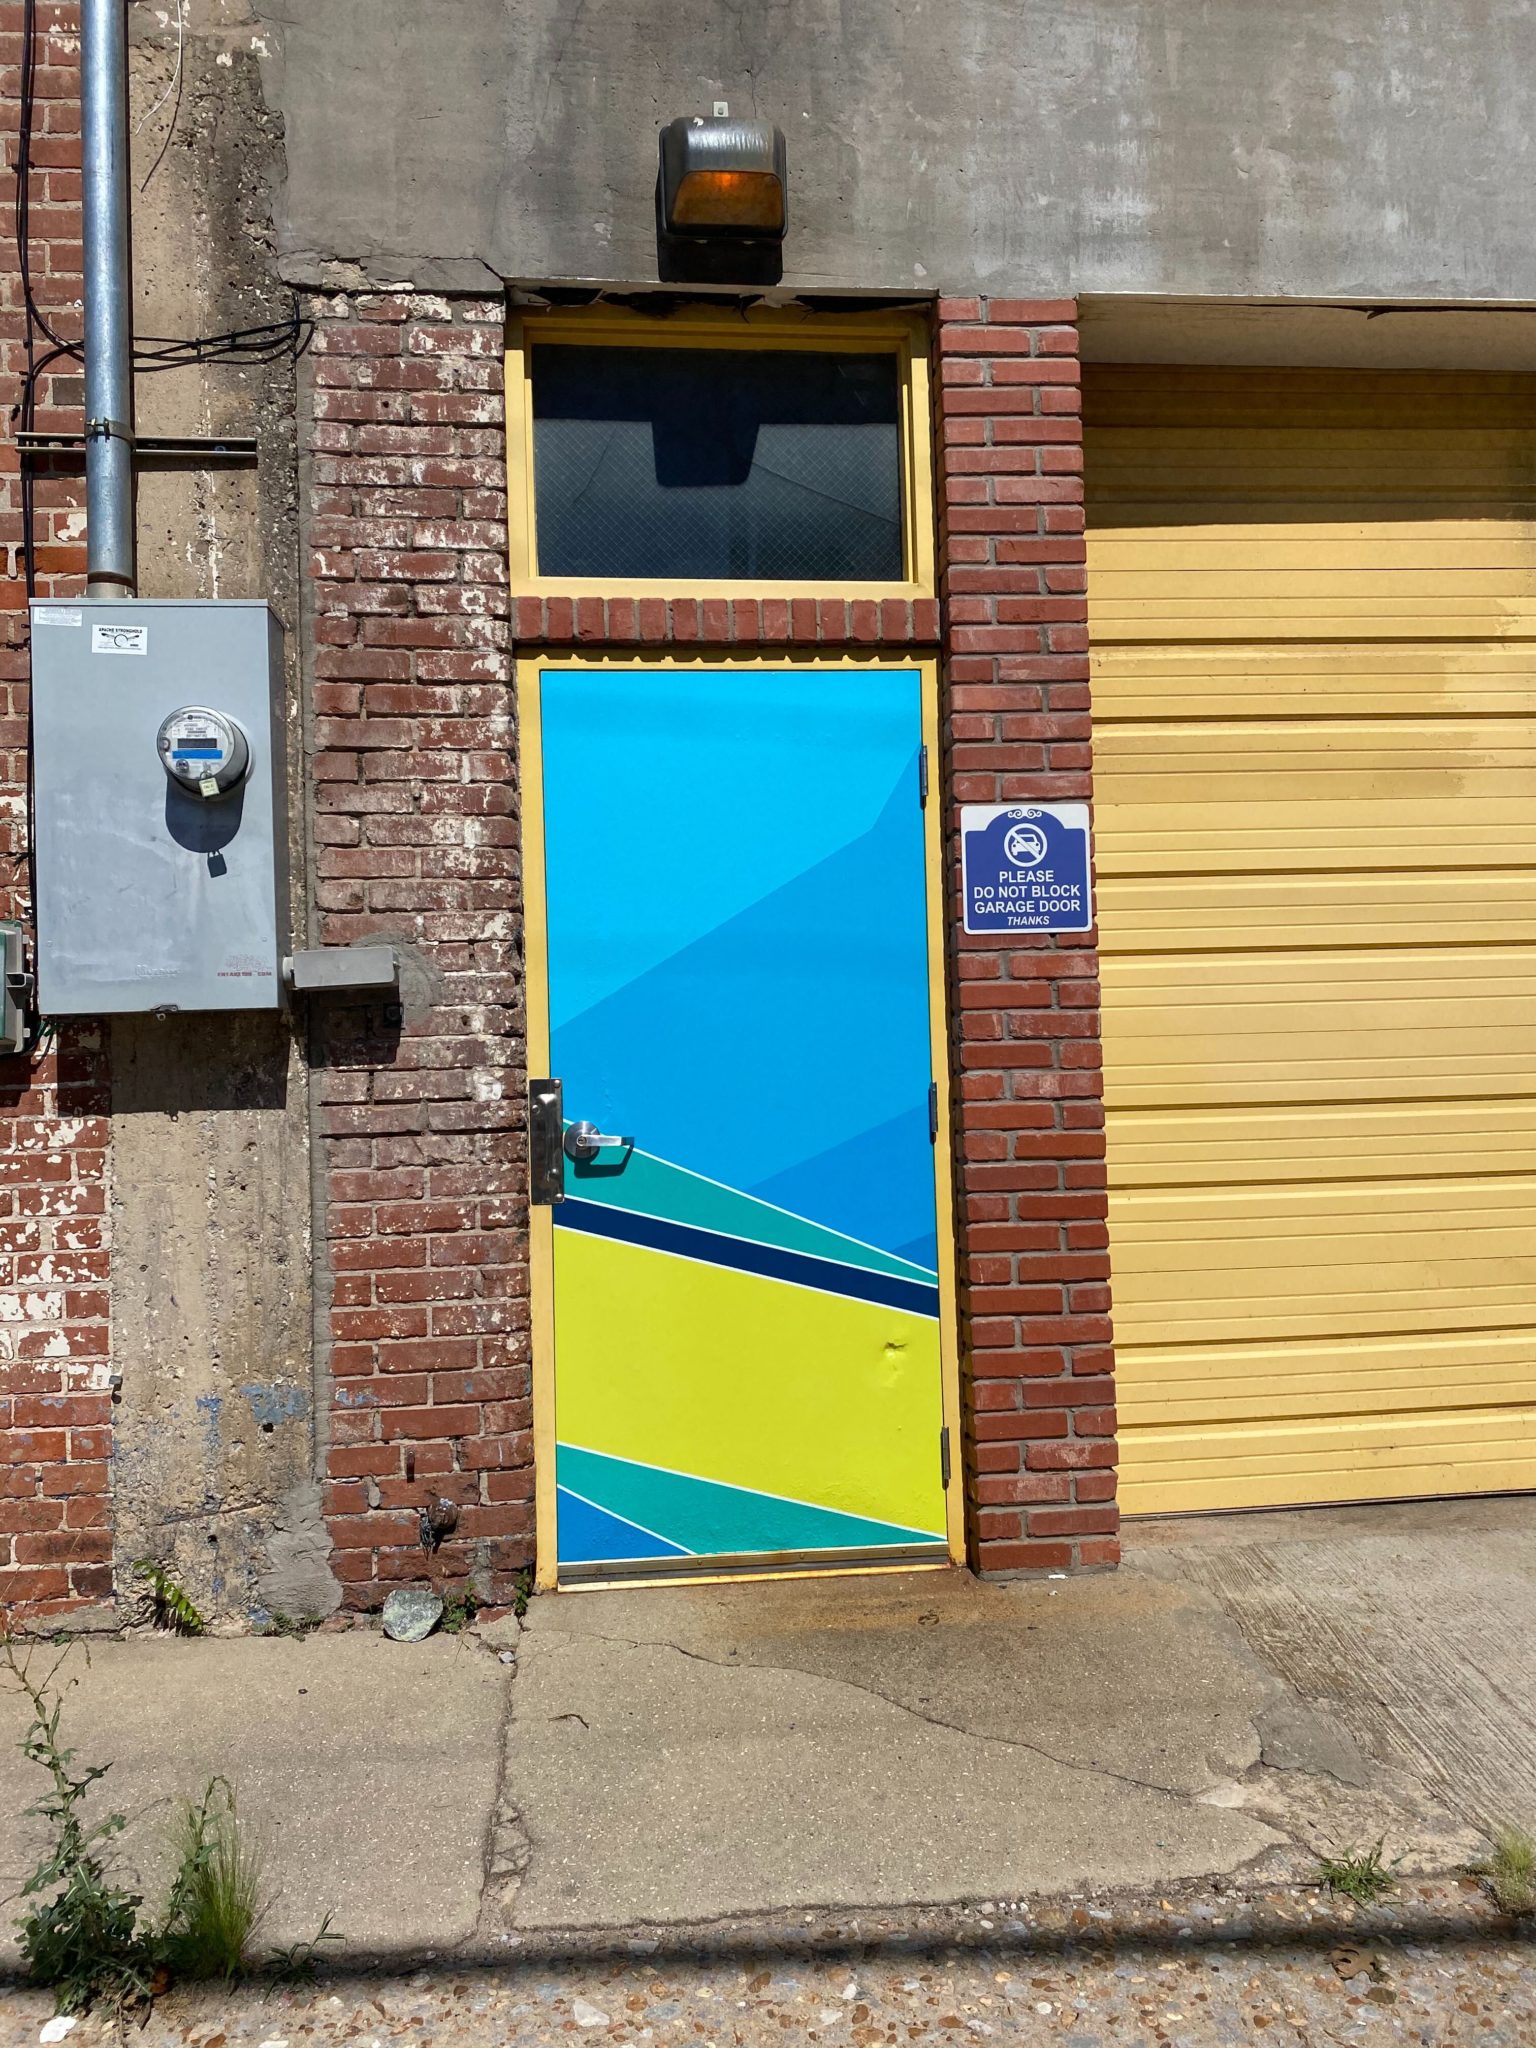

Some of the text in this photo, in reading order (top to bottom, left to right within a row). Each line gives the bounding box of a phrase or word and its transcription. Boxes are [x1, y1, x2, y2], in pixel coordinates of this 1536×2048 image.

[999, 870, 1055, 883] PLEASE
[974, 884, 1081, 899] DO NOT BLOCK
[974, 899, 1081, 913] GARAGE DOOR
[1007, 915, 1050, 926] THANKS
